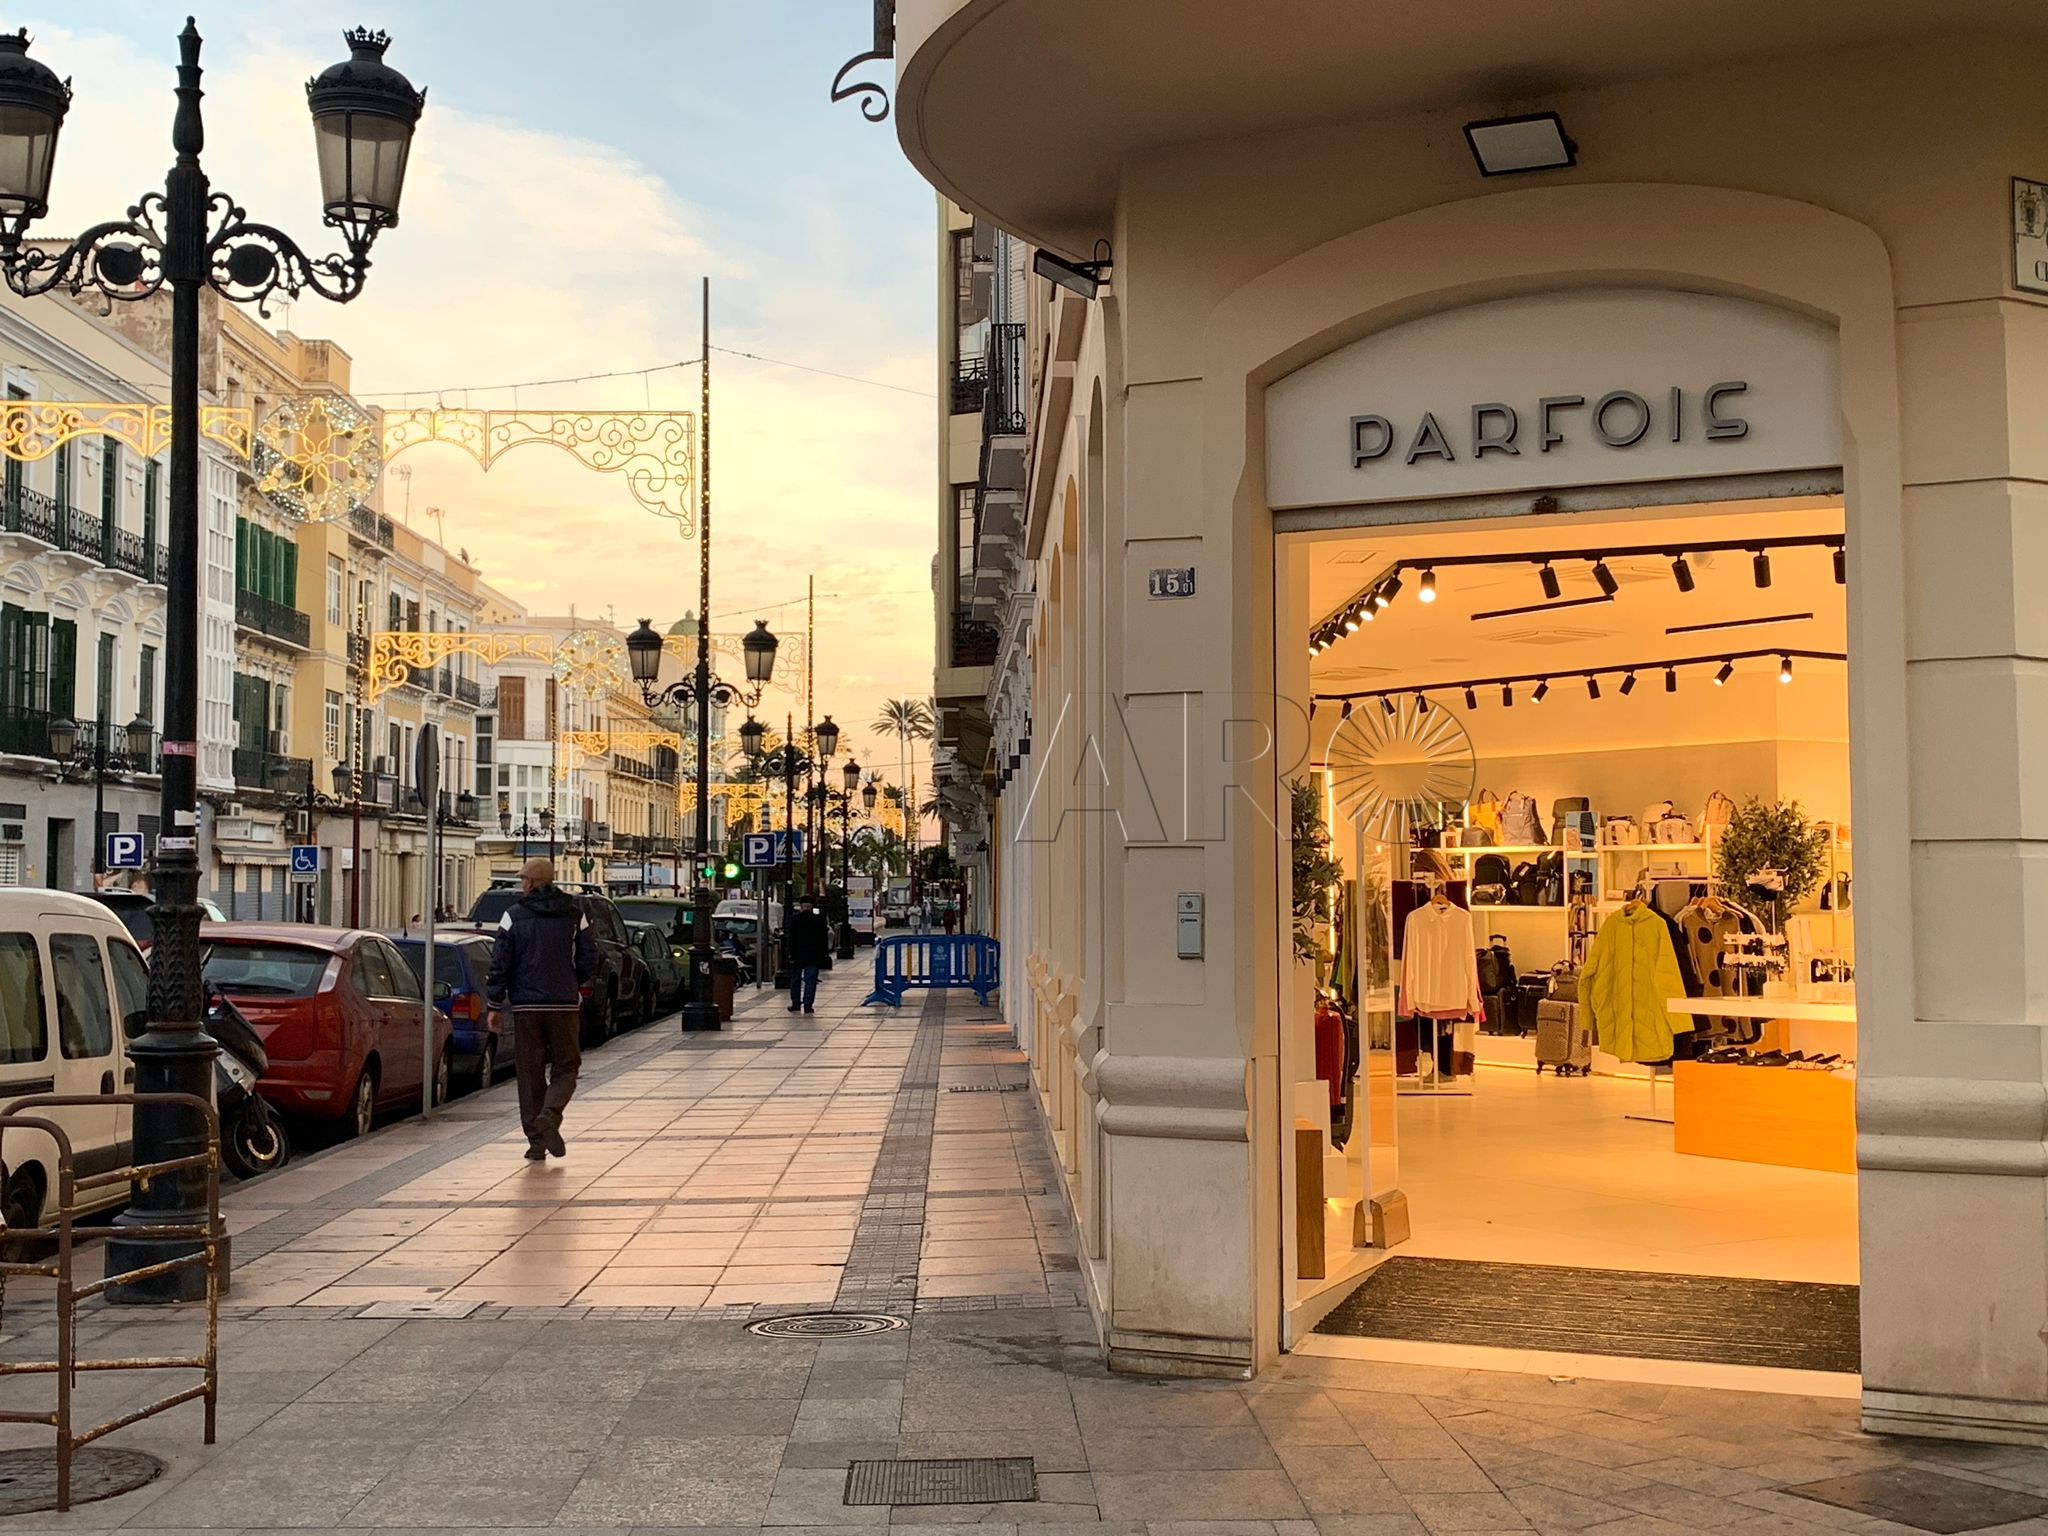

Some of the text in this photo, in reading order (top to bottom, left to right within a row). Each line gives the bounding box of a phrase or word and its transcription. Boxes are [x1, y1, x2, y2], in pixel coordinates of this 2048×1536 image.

[2035, 260, 2048, 282] C
[1350, 381, 1748, 468] PARFOIS
[1152, 574, 1179, 595] 15
[1183, 583, 1193, 593] 01
[114, 837, 136, 864] P
[749, 838, 769, 864] P
